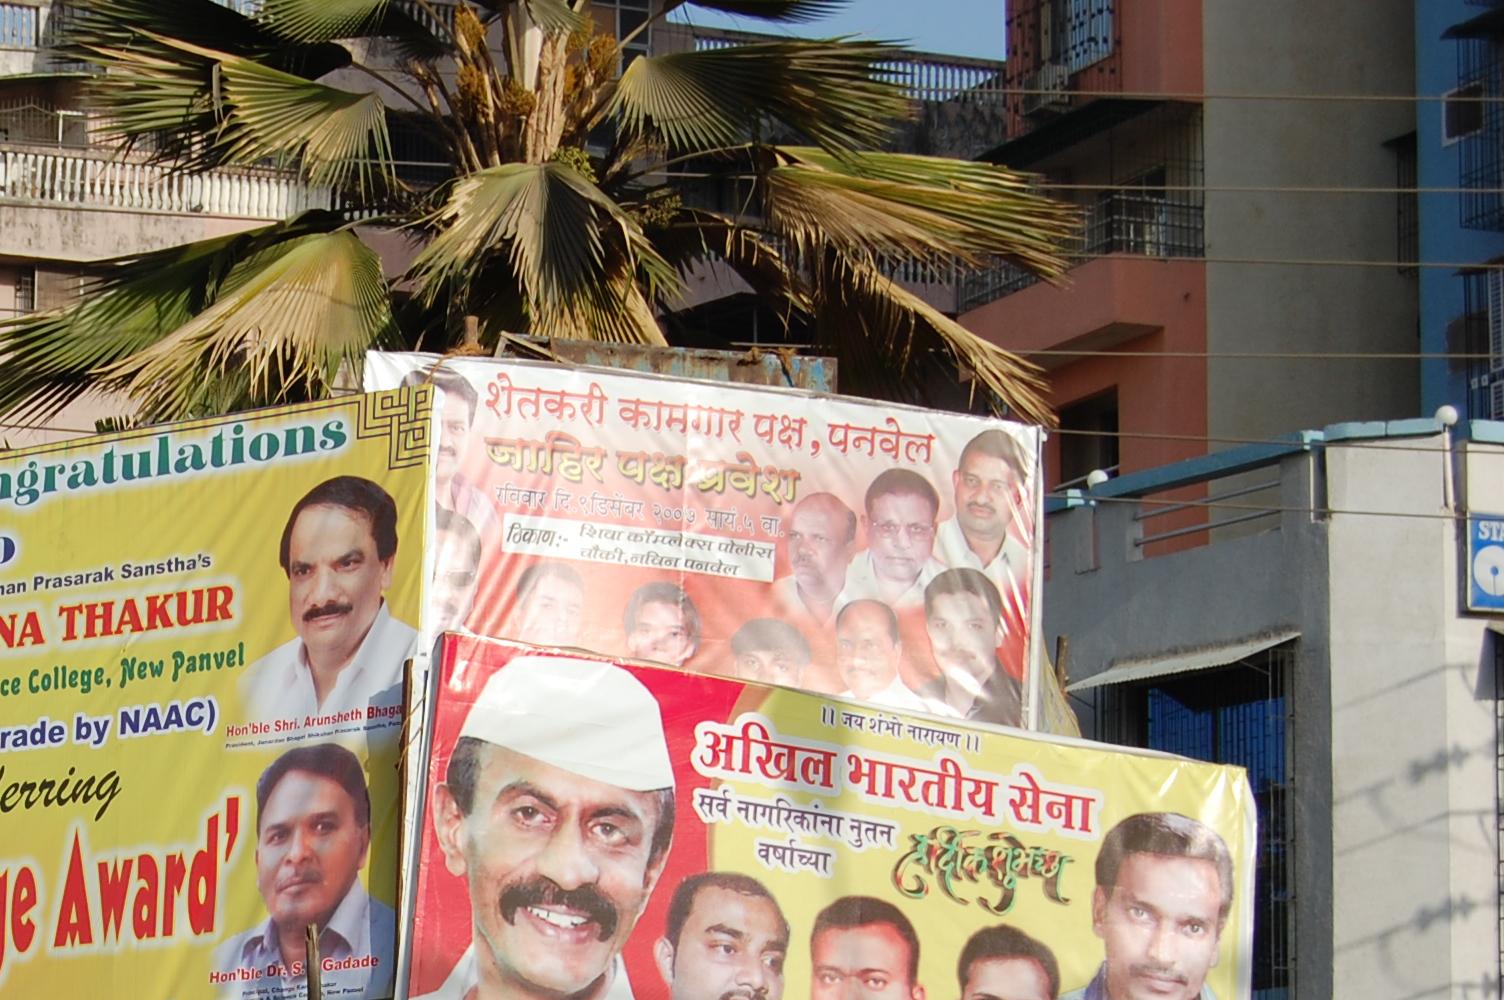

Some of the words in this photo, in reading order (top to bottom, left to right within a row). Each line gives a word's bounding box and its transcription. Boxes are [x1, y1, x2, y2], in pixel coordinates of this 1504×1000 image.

[33, 567, 114, 591] Prasarak
[58, 586, 234, 641] THAKUR
[29, 665, 111, 694] College,
[120, 657, 164, 688] New
[172, 641, 245, 682] Panvel
[76, 716, 109, 745] by
[120, 699, 216, 735] NAAC)
[841, 712, 864, 729] जय
[699, 721, 838, 788] अखिल
[847, 758, 999, 817] भारतीय
[1008, 772, 1096, 833] सेना
[698, 789, 733, 818] सर्व
[738, 795, 844, 837] नागरिकांना
[849, 819, 895, 848] नुतन
[758, 840, 832, 873] वर्षाच्या
[267, 965, 287, 977] Dr.
[322, 955, 379, 972] Gadade
